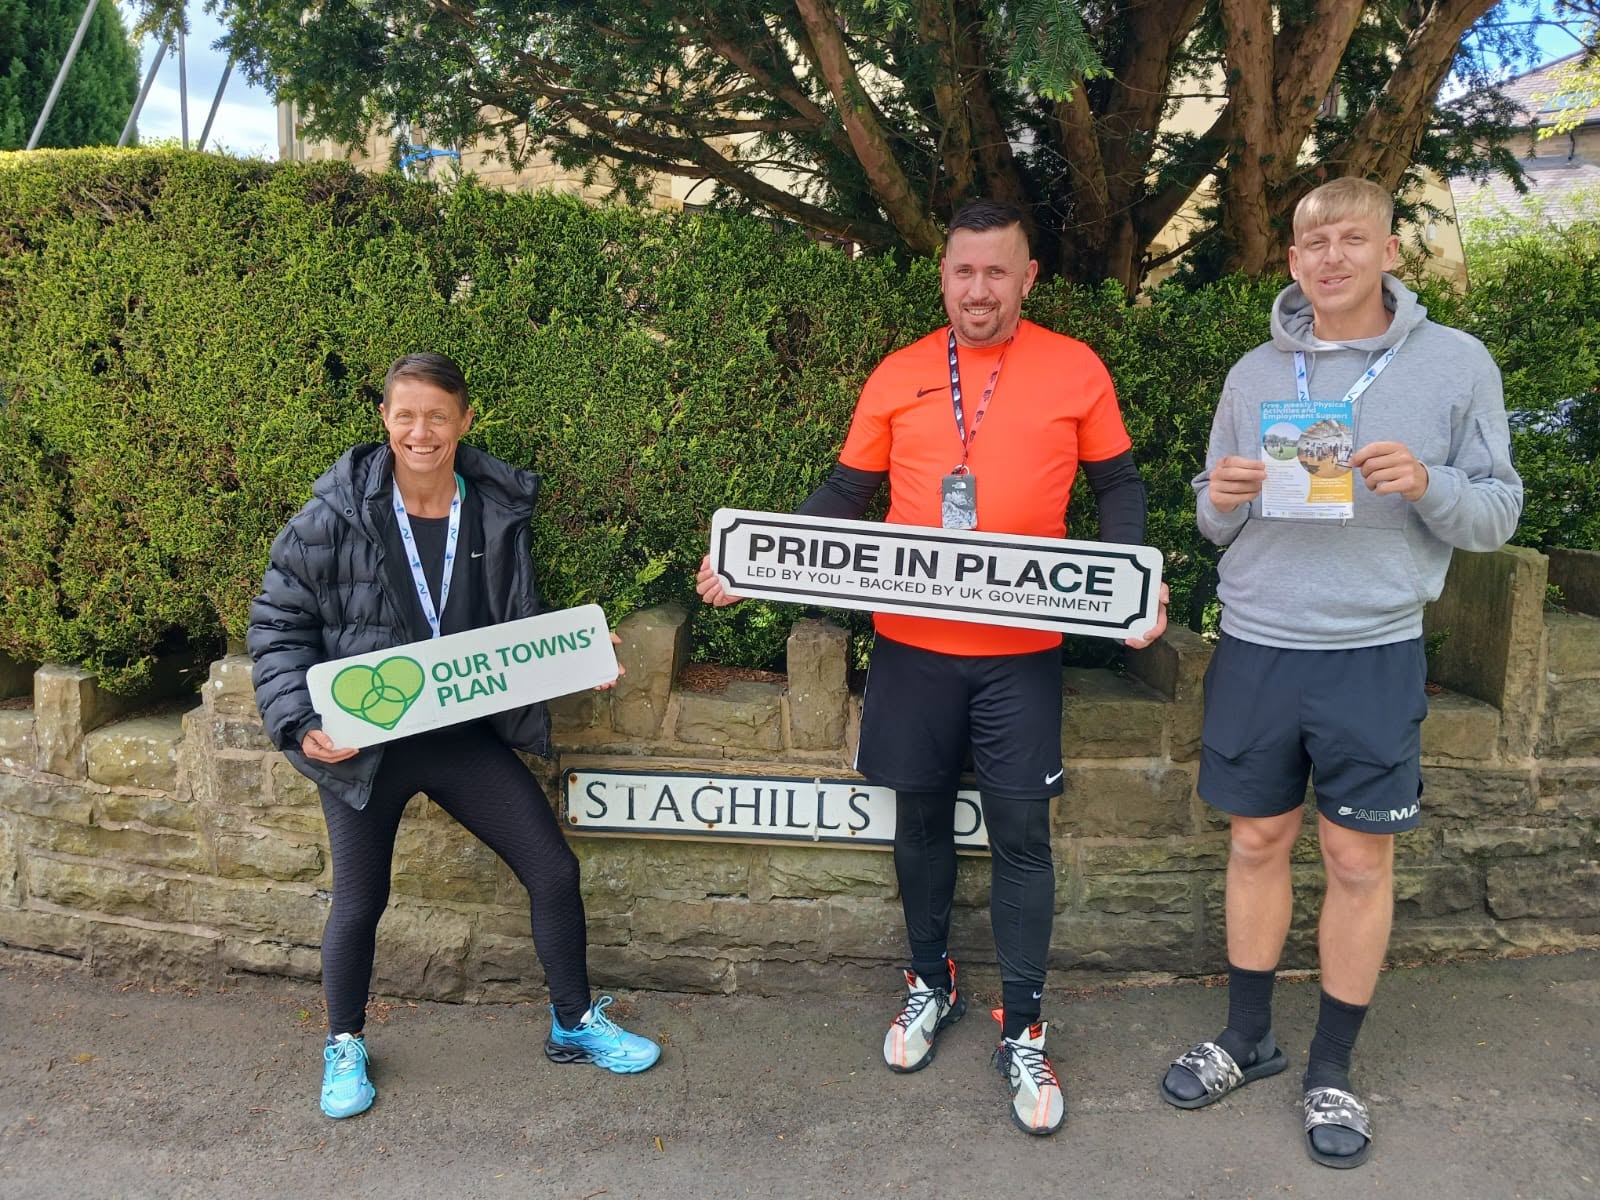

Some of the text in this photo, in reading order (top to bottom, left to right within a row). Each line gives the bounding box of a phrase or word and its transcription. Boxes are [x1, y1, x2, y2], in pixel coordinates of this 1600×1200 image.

[1313, 401, 1346, 409] Physical
[747, 565, 776, 578] LED
[781, 569, 802, 581] BY
[808, 571, 841, 586] YOU
[859, 577, 926, 595] BACKED
[931, 584, 954, 597] BY
[960, 587, 983, 600] UK
[988, 591, 1112, 613] GOVERNMENT
[748, 533, 1116, 597] PRIDE IN PLACE
[431, 626, 596, 683] OUR TOWNS'
[437, 672, 508, 707] PLAN
[585, 780, 982, 837] STAGHILLS D
[1320, 1091, 1348, 1106] NIKE
